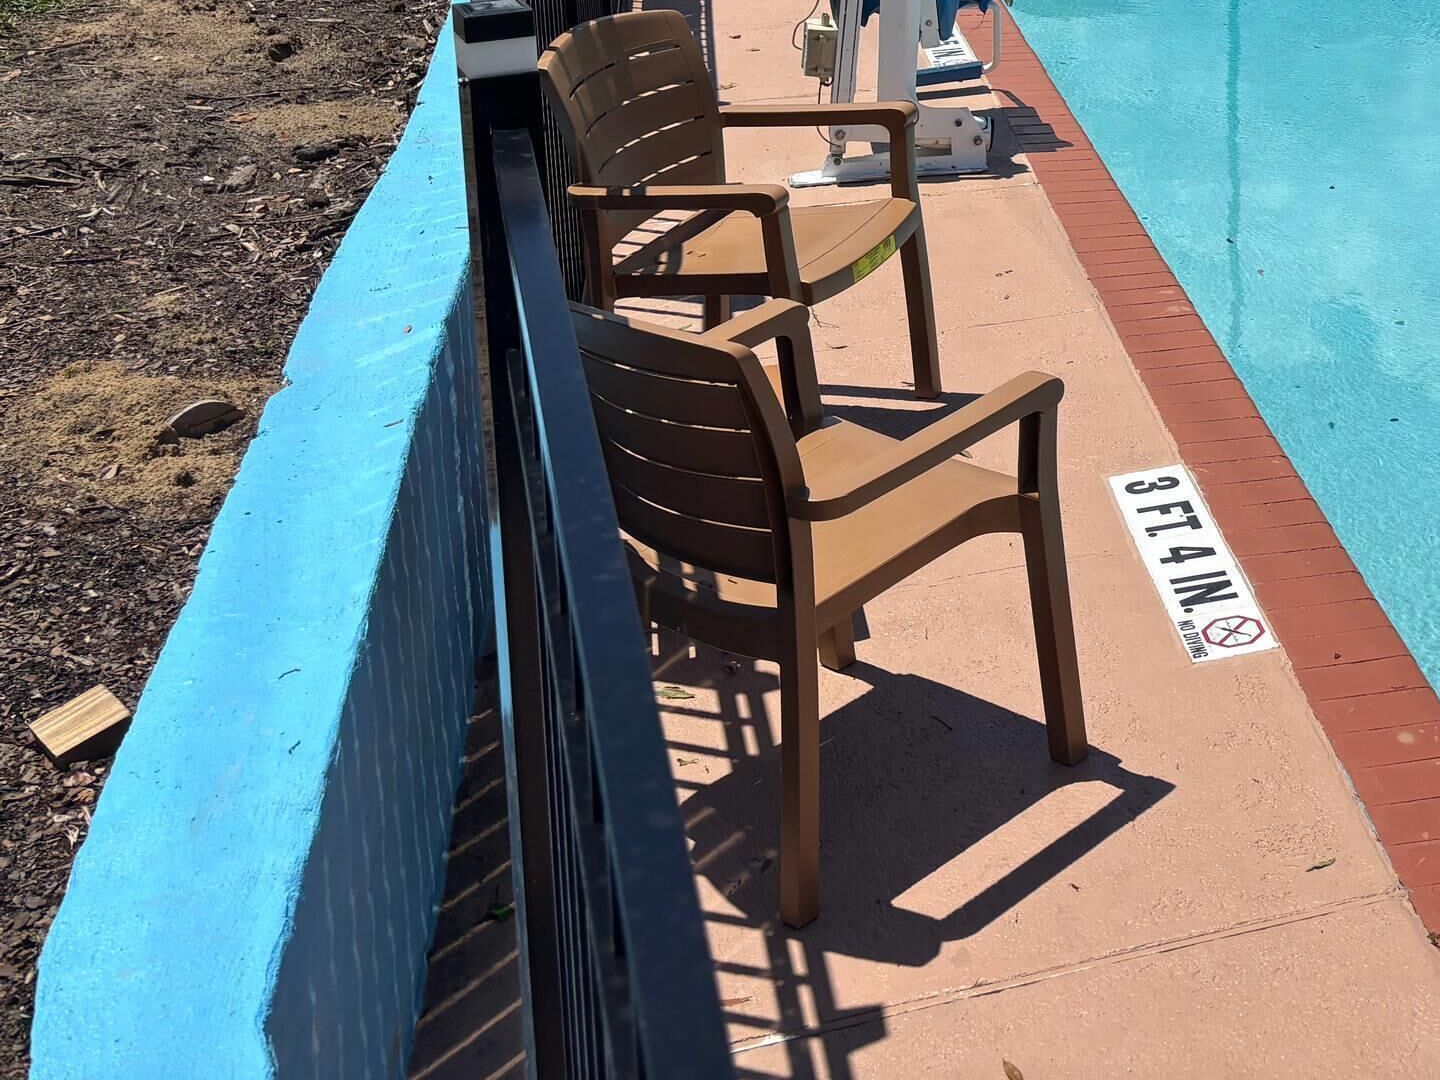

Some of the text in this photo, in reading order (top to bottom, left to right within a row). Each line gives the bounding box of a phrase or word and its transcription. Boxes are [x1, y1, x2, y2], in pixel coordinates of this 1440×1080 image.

[1124, 476, 1239, 613] 3 FT. 4 IN.
[1177, 619, 1209, 659] NO DIVING
